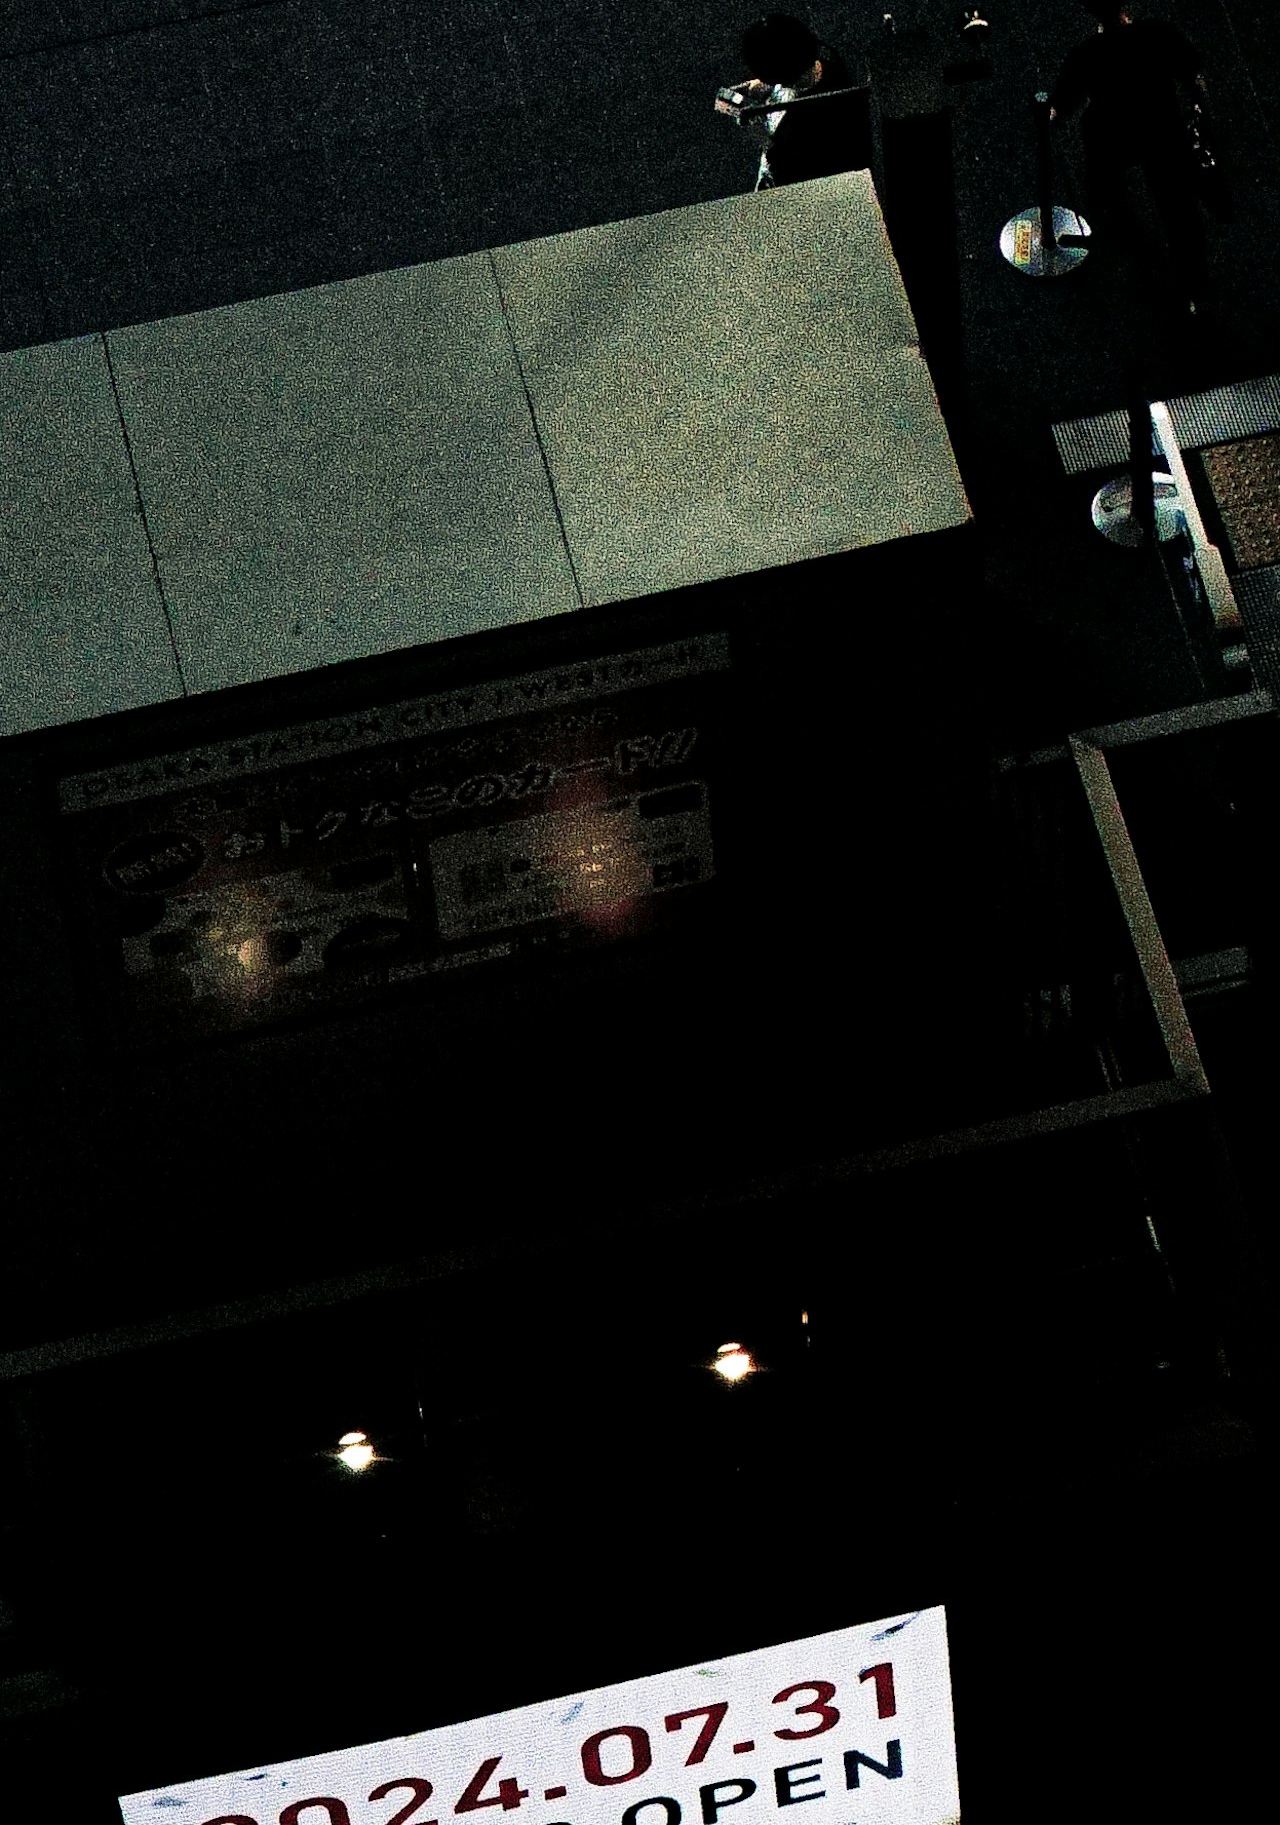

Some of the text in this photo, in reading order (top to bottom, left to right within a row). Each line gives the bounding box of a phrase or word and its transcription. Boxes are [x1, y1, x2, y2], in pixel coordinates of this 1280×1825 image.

[82, 755, 210, 797] OSAKA
[229, 715, 382, 767] STATION
[400, 696, 474, 727] CITY
[201, 1662, 897, 1825] 24.07.31
[621, 1739, 903, 1825] OPEN
